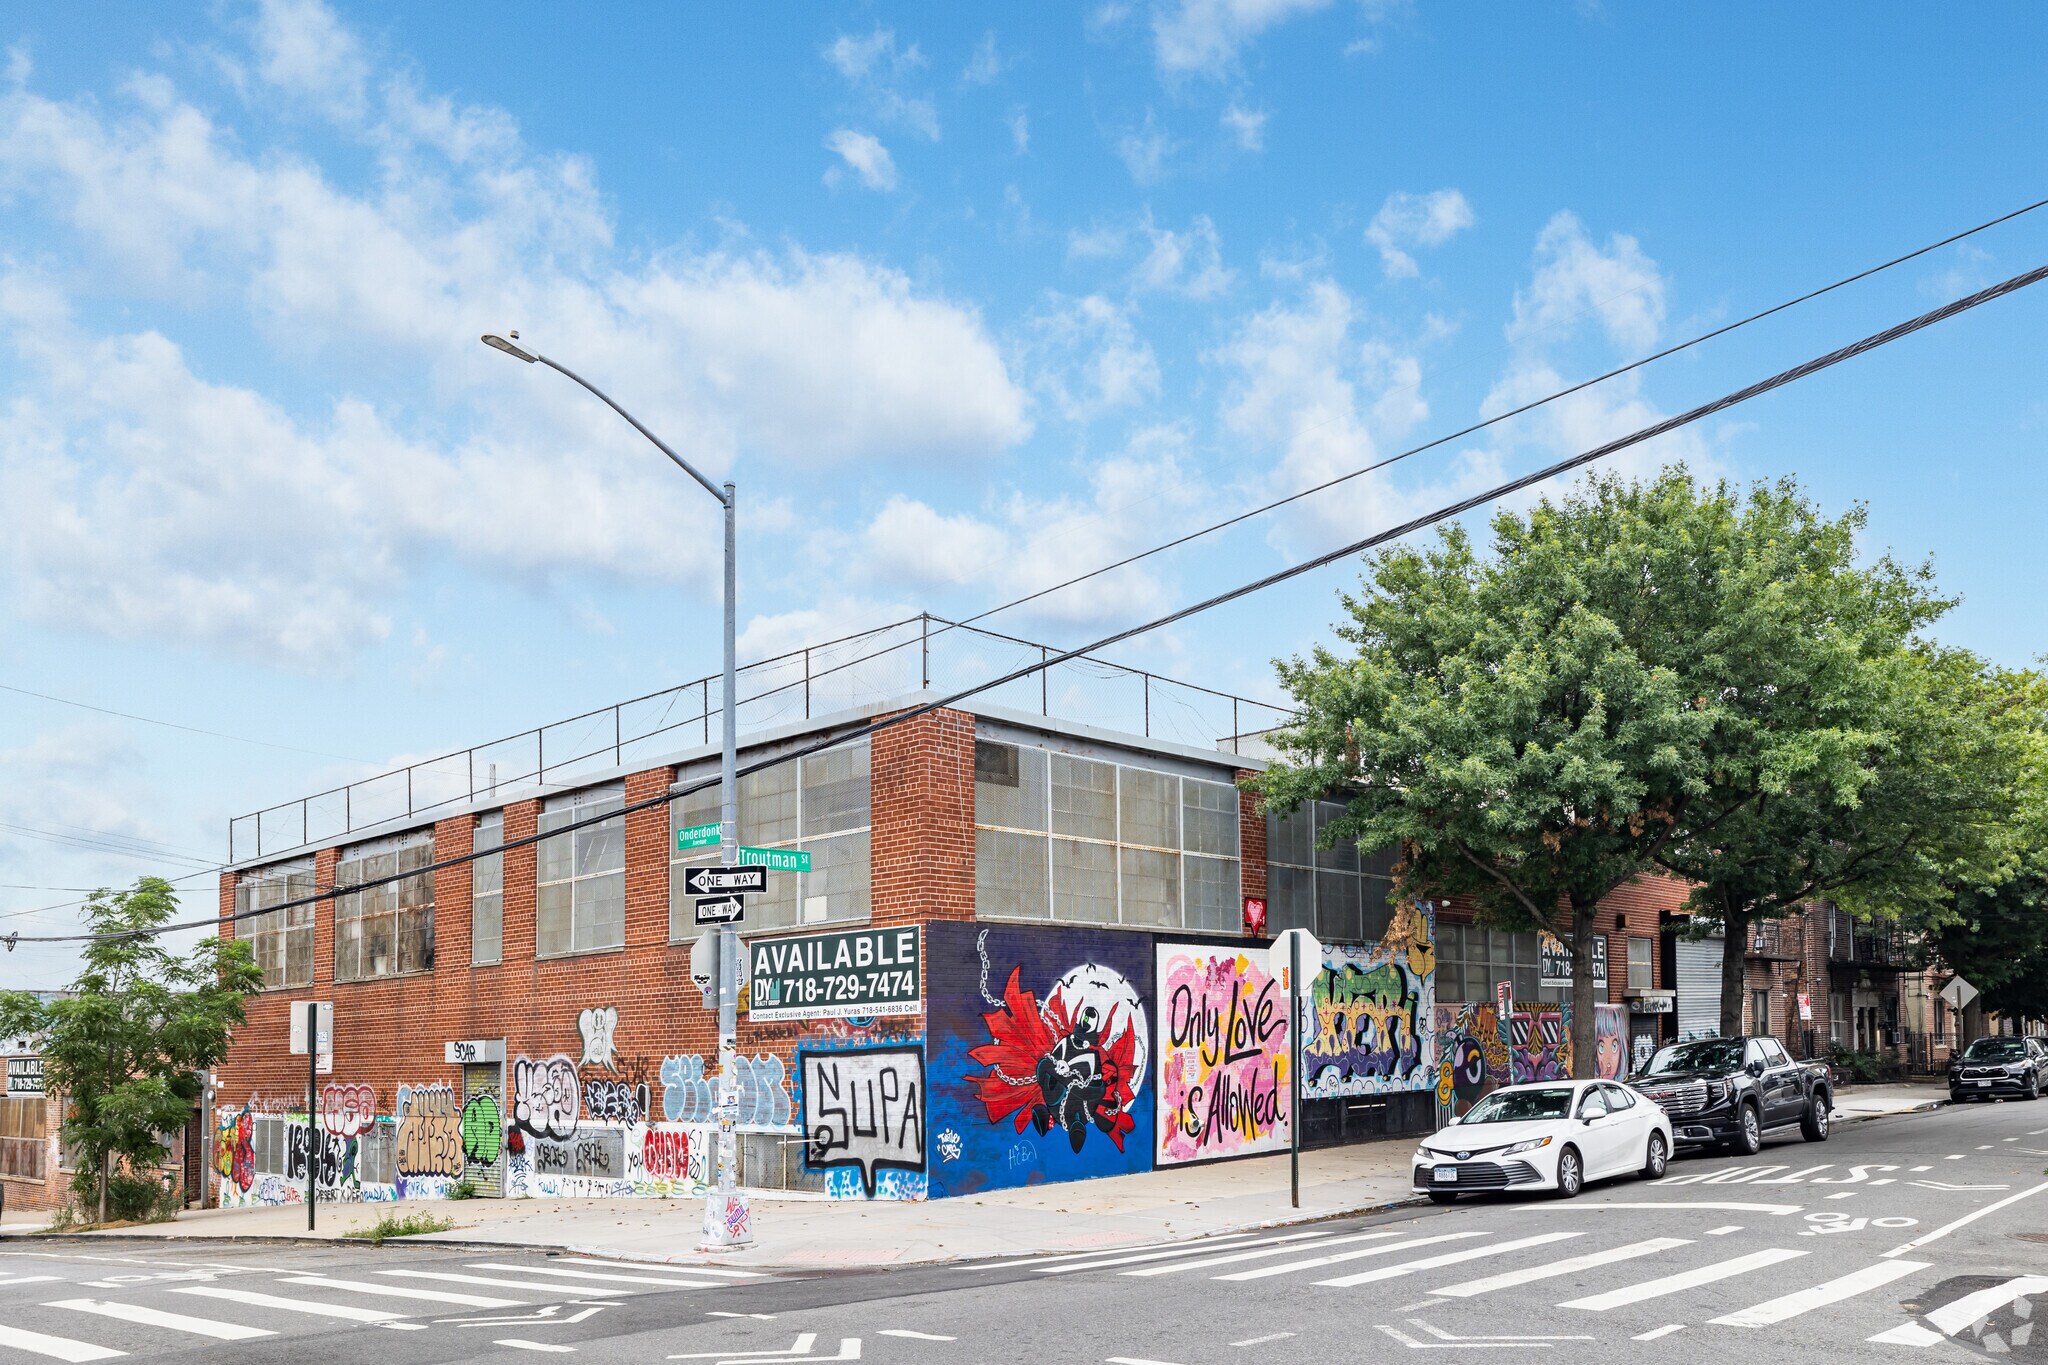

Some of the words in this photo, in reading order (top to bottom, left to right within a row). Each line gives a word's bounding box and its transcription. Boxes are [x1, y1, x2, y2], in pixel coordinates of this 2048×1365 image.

[680, 825, 721, 841] Onderdonk
[740, 849, 797, 868] Troutman
[801, 854, 809, 864] St
[698, 875, 722, 887] ONE
[734, 873, 756, 885] WAY
[702, 906, 716, 917] ONE
[722, 903, 737, 914] WAY
[754, 932, 914, 976] AVAILABLE
[754, 978, 772, 1001] DY
[783, 970, 914, 1003] 718-729-7474
[752, 1012, 774, 1020] Contact
[774, 1010, 801, 1019] Exclusive
[802, 1009, 822, 1018] Agent:
[823, 1008, 836, 1016] Paul
[837, 1007, 842, 1016] J.
[843, 1007, 860, 1015] Yuras
[862, 1004, 903, 1014] 718-541-6836
[904, 1004, 918, 1012] Cell
[1171, 984, 1219, 1067] Only
[454, 1042, 477, 1062] SCAR
[8, 1061, 44, 1076] AVAILABLE
